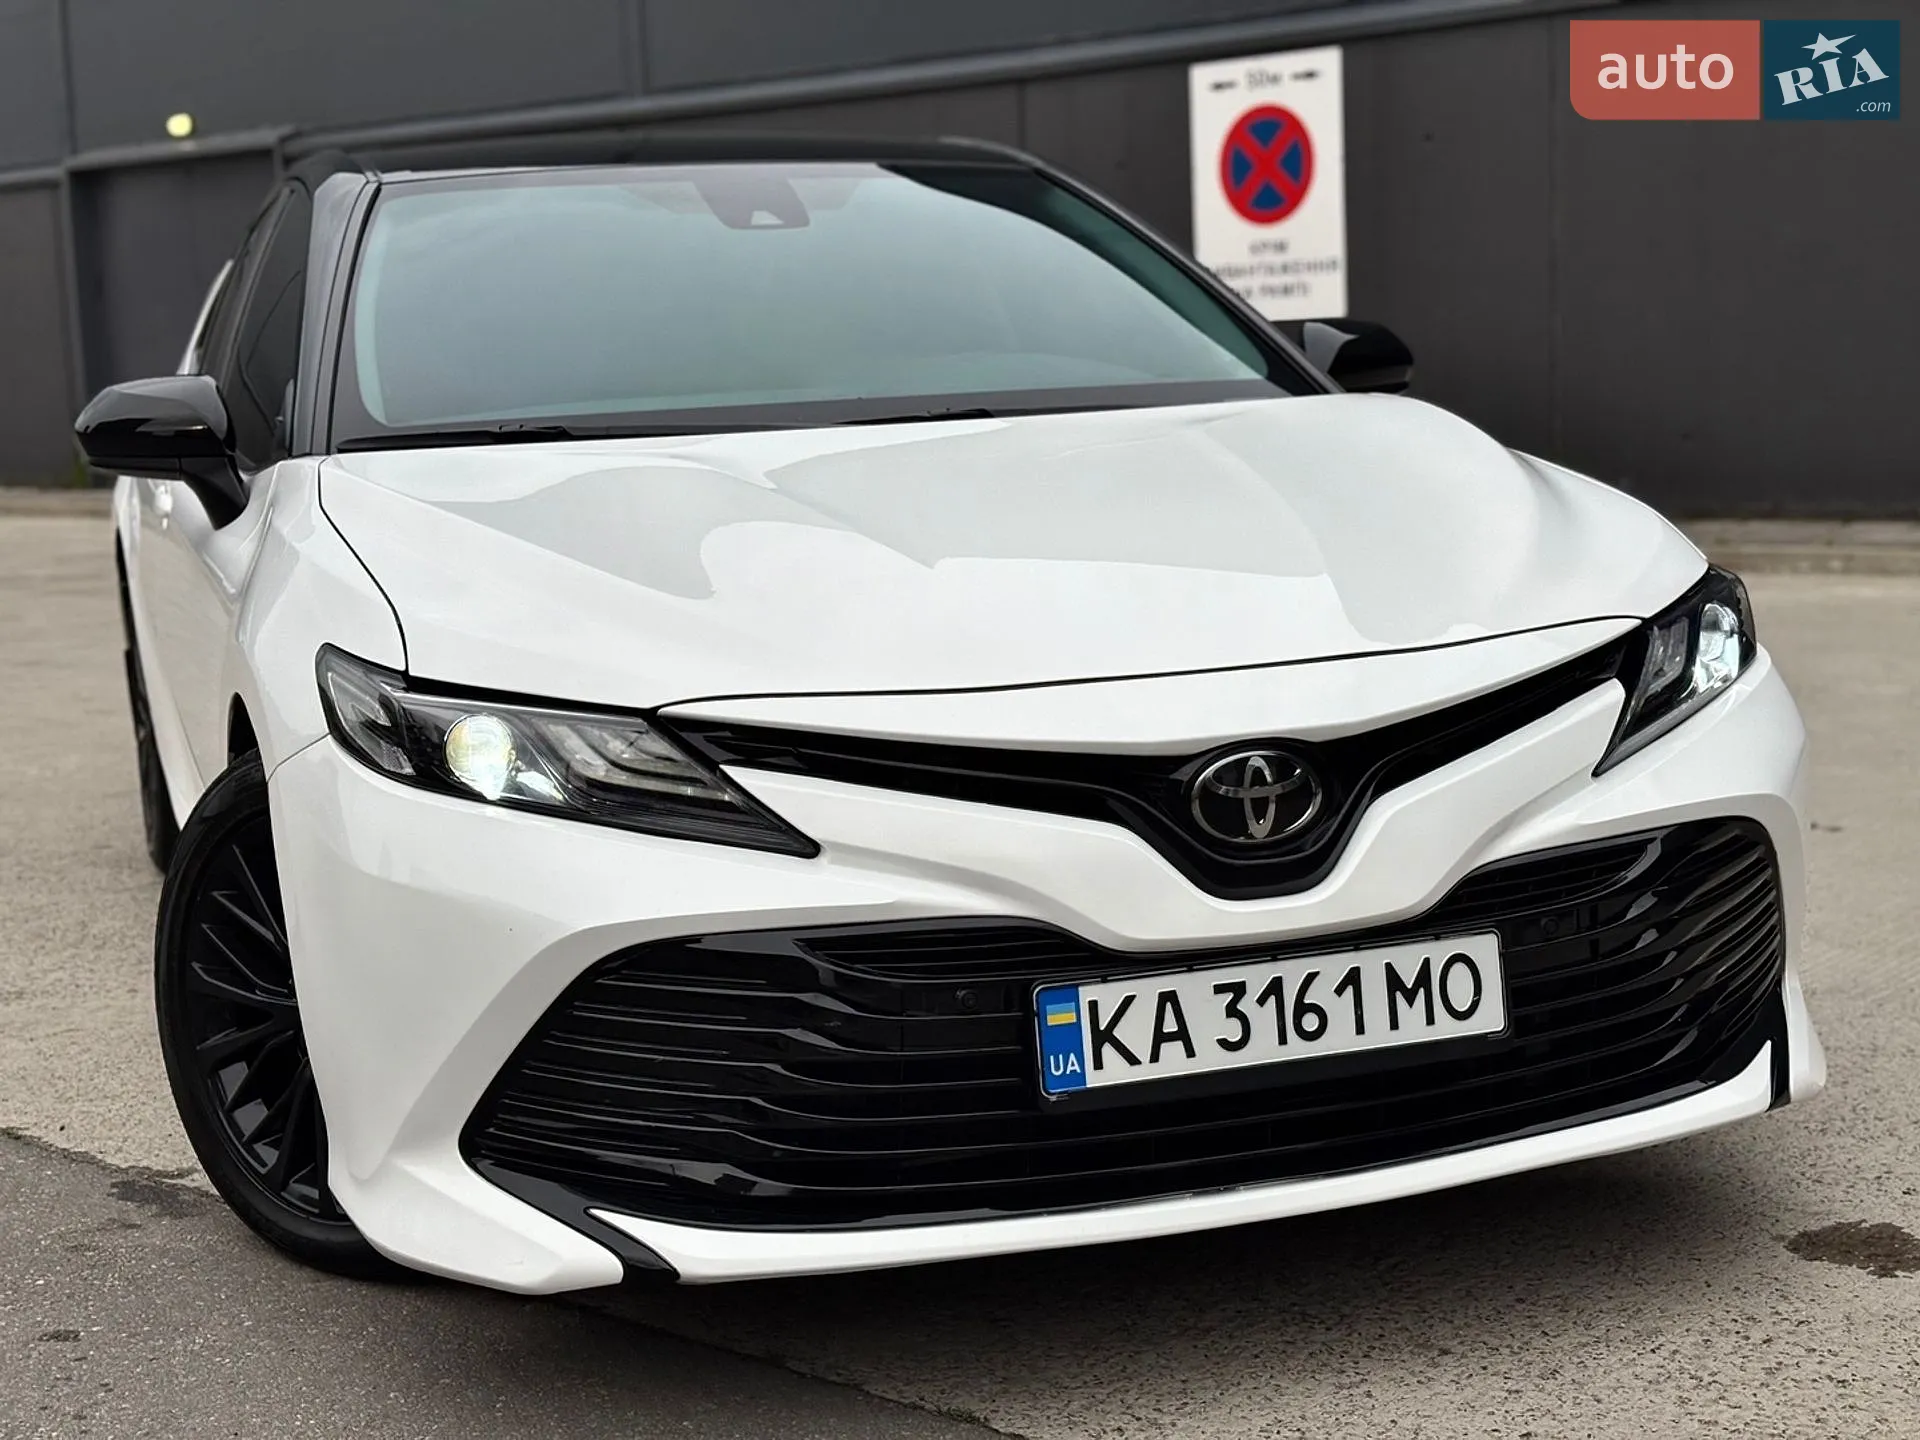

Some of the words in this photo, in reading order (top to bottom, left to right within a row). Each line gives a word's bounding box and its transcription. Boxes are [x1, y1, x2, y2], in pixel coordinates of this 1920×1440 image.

[1088, 988, 1198, 1070] KA
[1213, 965, 1366, 1052] 3161
[1384, 952, 1483, 1031] MO
[1050, 1053, 1081, 1076] UA
